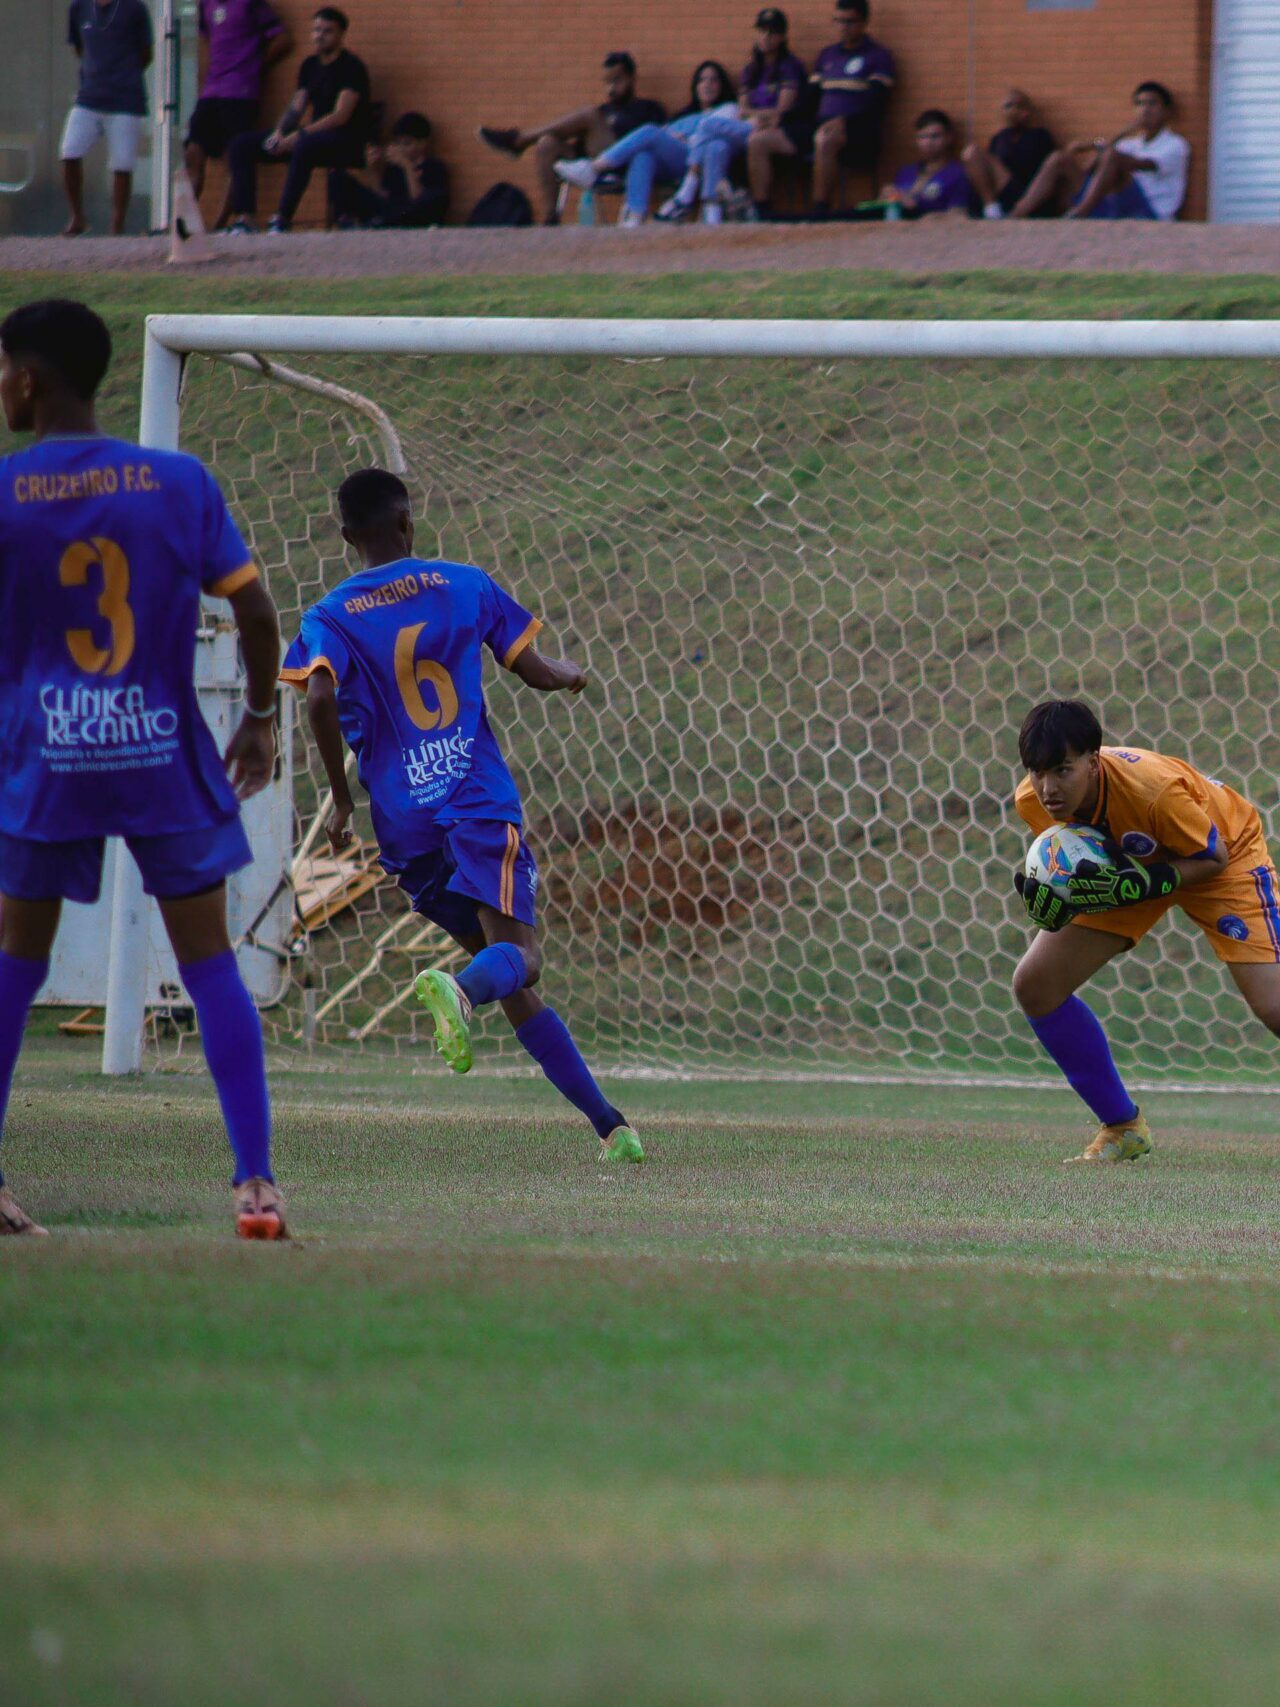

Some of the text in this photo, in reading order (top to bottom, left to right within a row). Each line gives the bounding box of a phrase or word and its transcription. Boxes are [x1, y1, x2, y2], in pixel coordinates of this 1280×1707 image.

[14, 463, 161, 504] CRUZEIRO F.C.
[59, 536, 136, 677] 3
[344, 572, 450, 614] CRUZEIRO F.C.
[394, 621, 460, 732] 6
[39, 681, 145, 717] CLÍNICA
[46, 707, 179, 746] RECANTO
